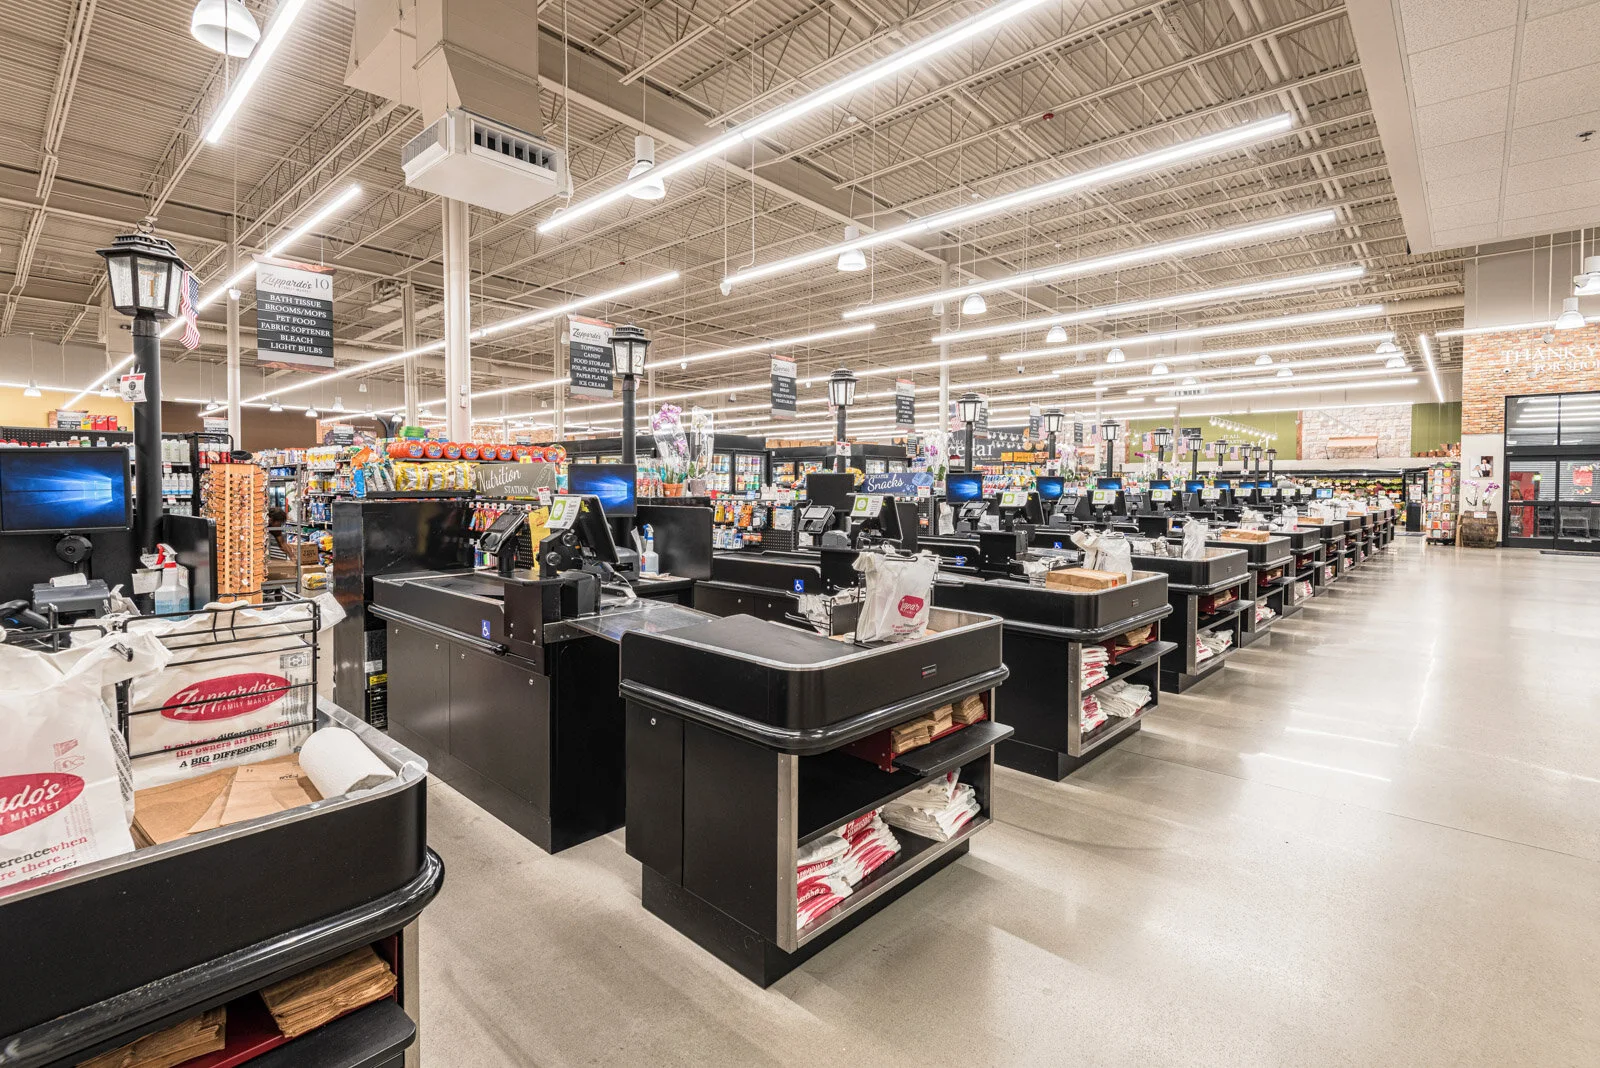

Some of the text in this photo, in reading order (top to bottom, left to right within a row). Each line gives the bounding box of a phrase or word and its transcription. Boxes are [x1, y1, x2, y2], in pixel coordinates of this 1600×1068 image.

[314, 278, 330, 290] 10
[270, 294, 321, 308] BATH TISSUE
[265, 303, 327, 319] BROOMS/MOPS
[276, 314, 316, 326] PET FOOD
[261, 322, 330, 337] FABRIC SOFTENER
[280, 334, 313, 345] BLEACH
[270, 342, 323, 354] LIGHT BULBS
[580, 344, 604, 353] TOPPINGS
[1501, 346, 1576, 362] THANK
[573, 357, 588, 365] FOOD
[634, 355, 642, 368] 2
[1534, 361, 1560, 373] FOR
[947, 437, 993, 457] celar
[477, 465, 522, 493] Nutrition
[867, 473, 905, 492] Snacks
[503, 485, 529, 495] STATION
[217, 693, 276, 713] FAMILY MARKET
[266, 720, 290, 730] when
[175, 748, 193, 758] the
[195, 741, 232, 753] owners
[235, 738, 248, 746] are
[179, 739, 278, 769] A BIG DIFFERENCE!
[10, 800, 61, 823] MARKET
[50, 836, 88, 854] when
